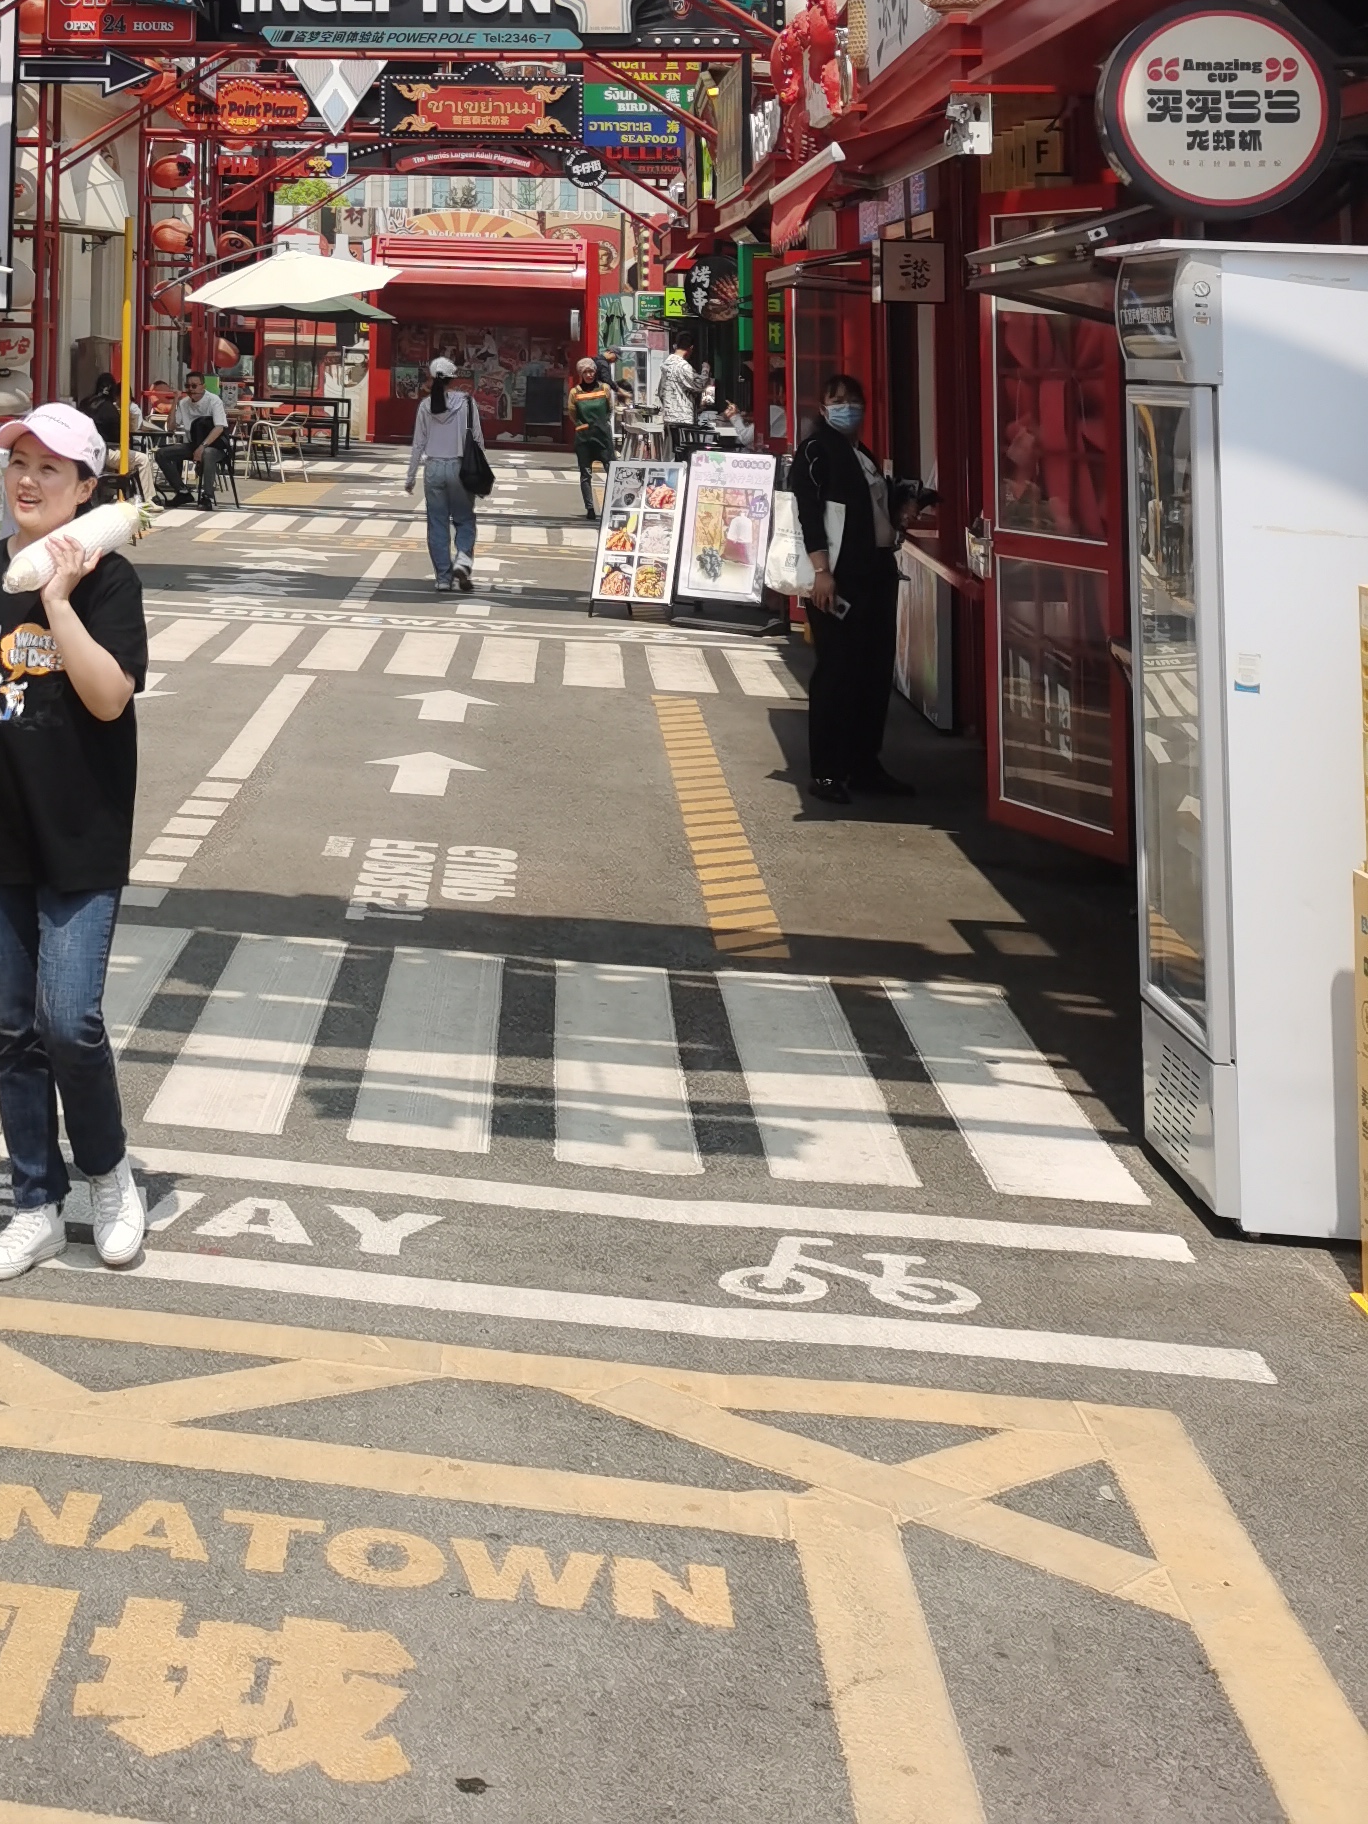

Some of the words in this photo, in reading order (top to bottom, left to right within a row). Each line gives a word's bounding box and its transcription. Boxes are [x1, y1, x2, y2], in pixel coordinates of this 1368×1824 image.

[64, 20, 97, 31] OPEN
[102, 14, 127, 33] 24
[133, 21, 174, 32] HOURS
[293, 30, 386, 44] 盗梦空间体验站
[386, 31, 436, 44] POWER
[438, 32, 477, 44] POLE
[483, 33, 551, 45] Tel:2346-7
[1183, 58, 1263, 74] Amazing
[660, 72, 682, 81] FIN
[1207, 72, 1238, 83] CUP
[227, 100, 262, 117] Point
[262, 101, 298, 118] Plaza
[617, 102, 648, 112] BIRD
[620, 134, 678, 144] SEAFOOD
[1186, 129, 1263, 152] 龙虾杯
